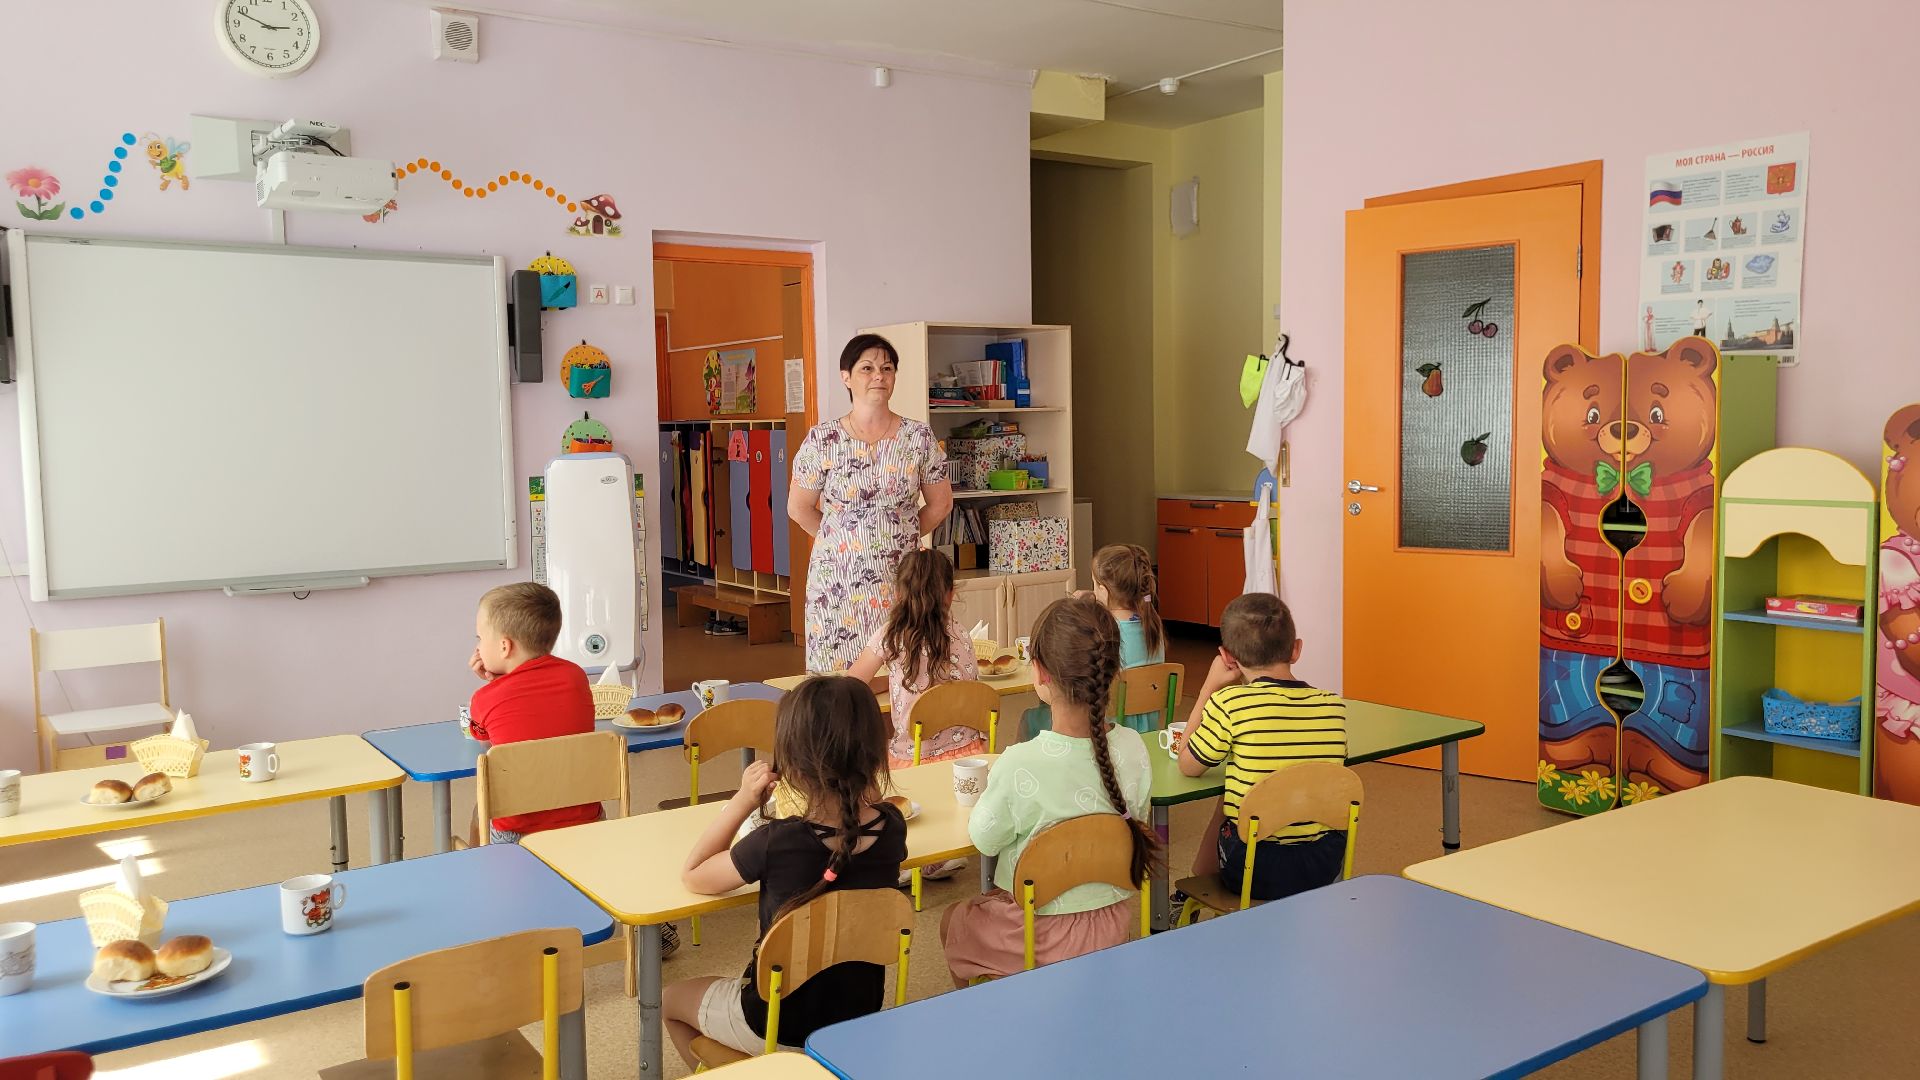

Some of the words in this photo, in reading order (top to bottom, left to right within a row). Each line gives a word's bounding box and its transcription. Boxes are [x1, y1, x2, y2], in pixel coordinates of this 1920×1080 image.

[237, 5, 248, 14] 10
[281, 1, 287, 10] 1
[291, 12, 298, 21] 2
[233, 19, 240, 28] 9
[297, 28, 303, 37] 3
[239, 34, 246, 43] 8
[249, 46, 256, 54] 7
[292, 41, 299, 50] 4
[267, 53, 274, 61] 6
[283, 50, 290, 59] 5
[1676, 157, 1693, 168] МОЯ
[1695, 152, 1726, 165] СТРАНА
[1741, 145, 1775, 158] РОССИЯ
